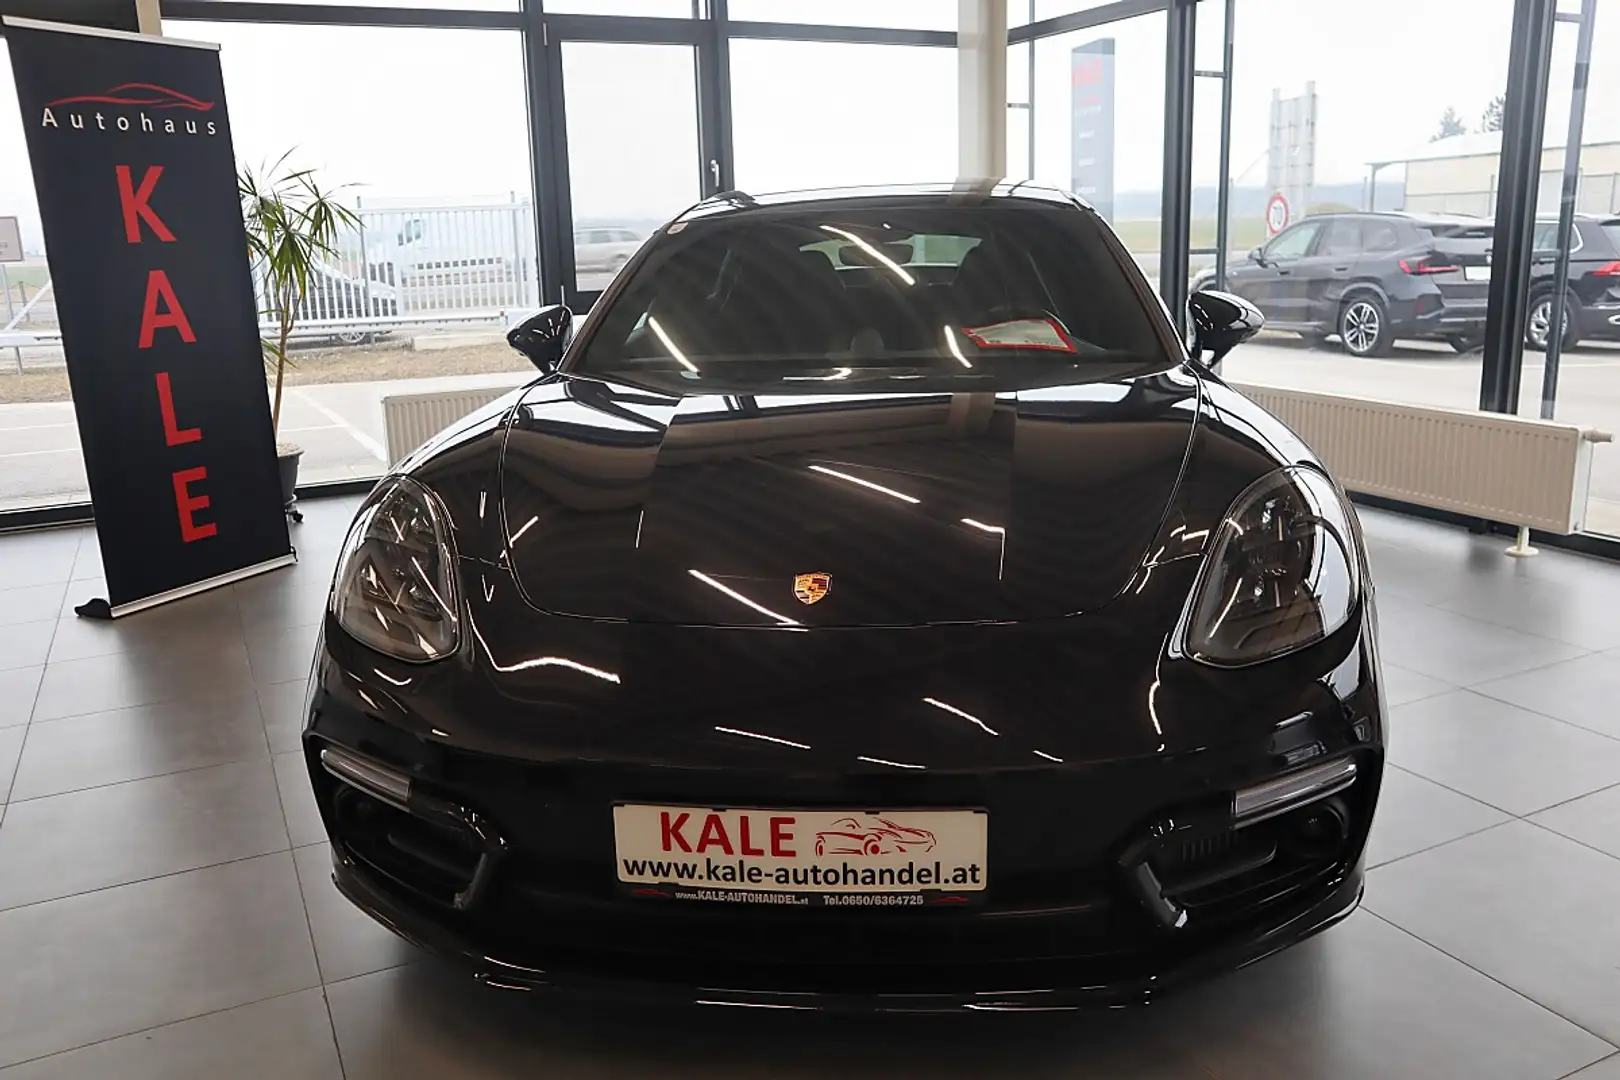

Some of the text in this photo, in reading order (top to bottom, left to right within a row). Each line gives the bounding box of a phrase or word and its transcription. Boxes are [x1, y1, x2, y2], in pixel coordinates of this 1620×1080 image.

[41, 107, 216, 135] Autohaus
[115, 164, 218, 543] KALE
[660, 811, 796, 857] KALE
[622, 857, 981, 886] www.kale-autohandel.at
